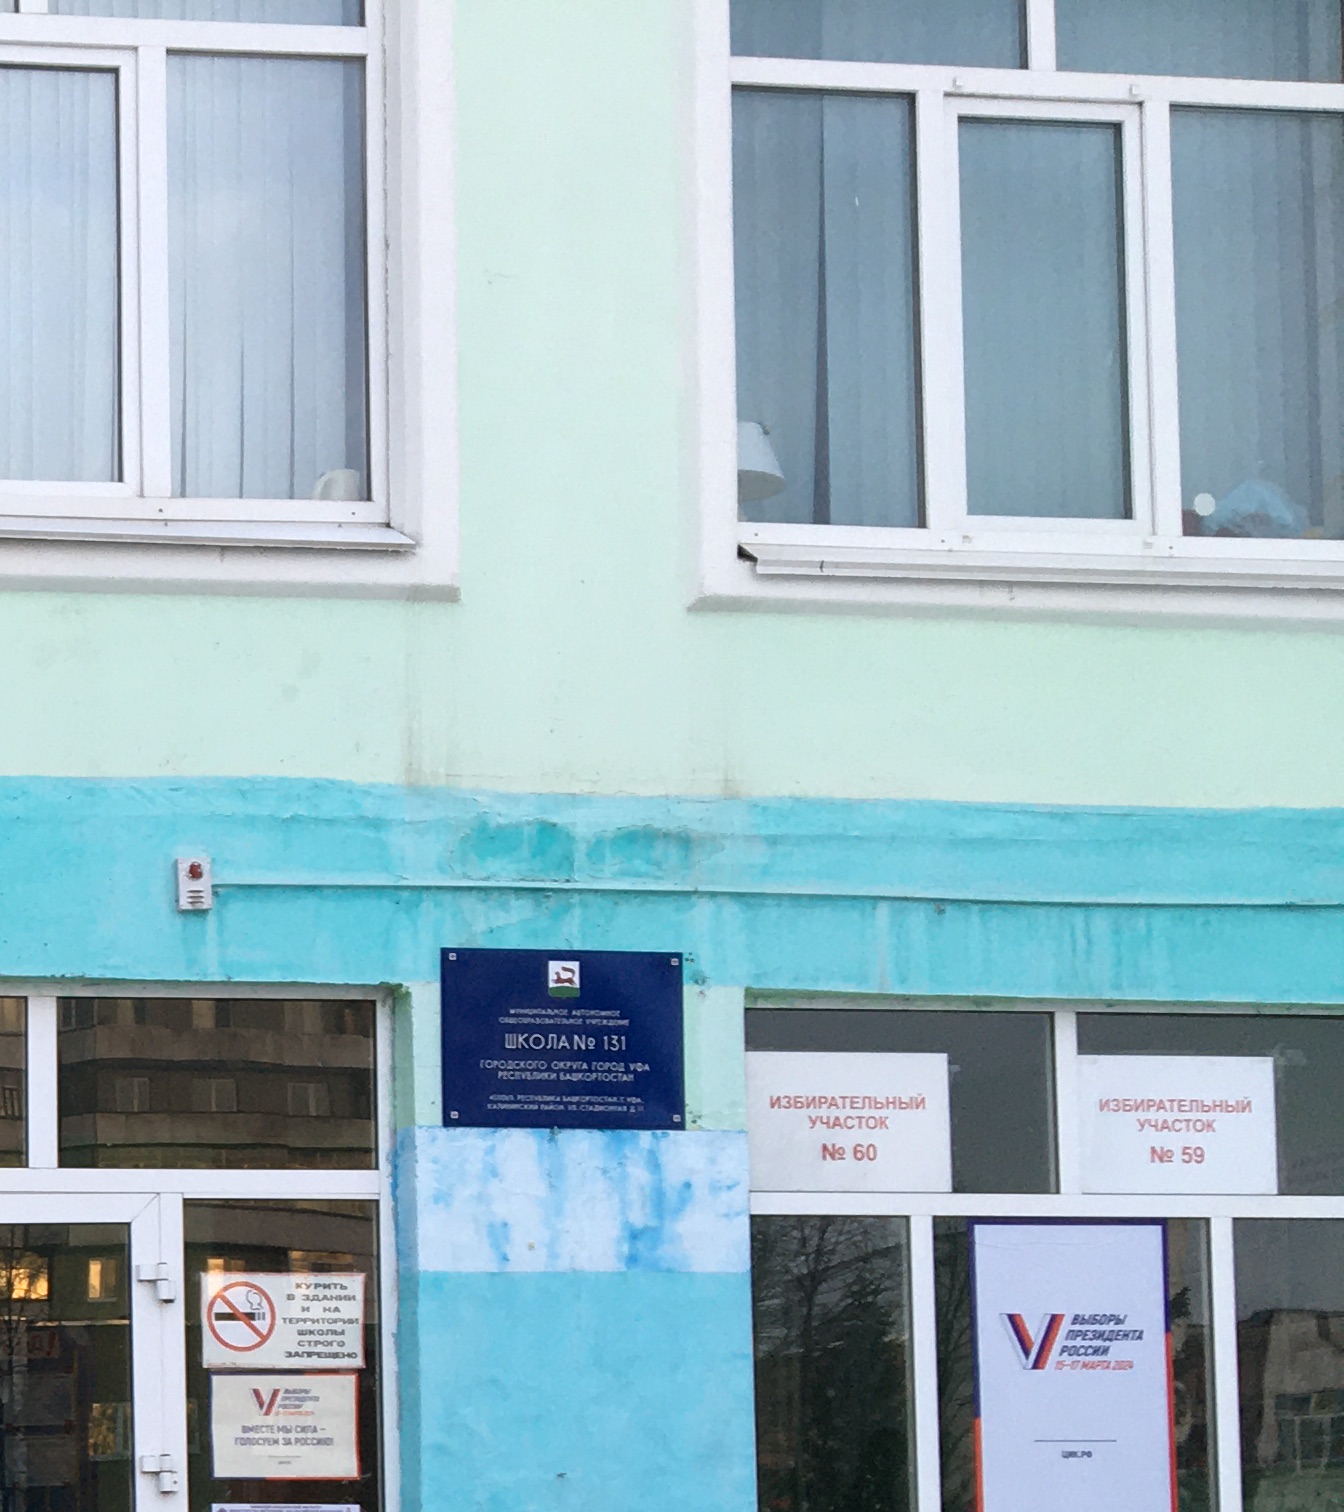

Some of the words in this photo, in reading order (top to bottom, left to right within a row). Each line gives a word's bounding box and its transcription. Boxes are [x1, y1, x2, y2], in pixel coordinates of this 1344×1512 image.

[505, 1033, 570, 1050] ШКОЛА
[574, 1034, 596, 1051] №
[603, 1035, 627, 1052] 131
[769, 1092, 926, 1111] ИЗБИРАТЕЛЬНЫЙ
[1098, 1096, 1253, 1115] ИЗБИРАТЕЛЬНЫЙ
[808, 1115, 889, 1131] УЧАСТОК
[1137, 1118, 1217, 1134] УЧАСТОК
[821, 1142, 846, 1162] №
[852, 1142, 878, 1162] 60
[1149, 1146, 1174, 1165] №
[1180, 1146, 1205, 1165] 59
[295, 1282, 348, 1290] КУРИТЬ
[286, 1293, 296, 1301] В
[301, 1294, 357, 1302] ЗДАНИИ
[281, 1317, 360, 1325] ТЕРРИТОРИИ
[1070, 1314, 1128, 1325] ВЫБОРЫ
[1065, 1329, 1144, 1342] ПРЕЗИДЕНТА
[284, 1351, 359, 1359] ЗАПРЕЩЕНО
[1059, 1345, 1110, 1357] РОССИИ
